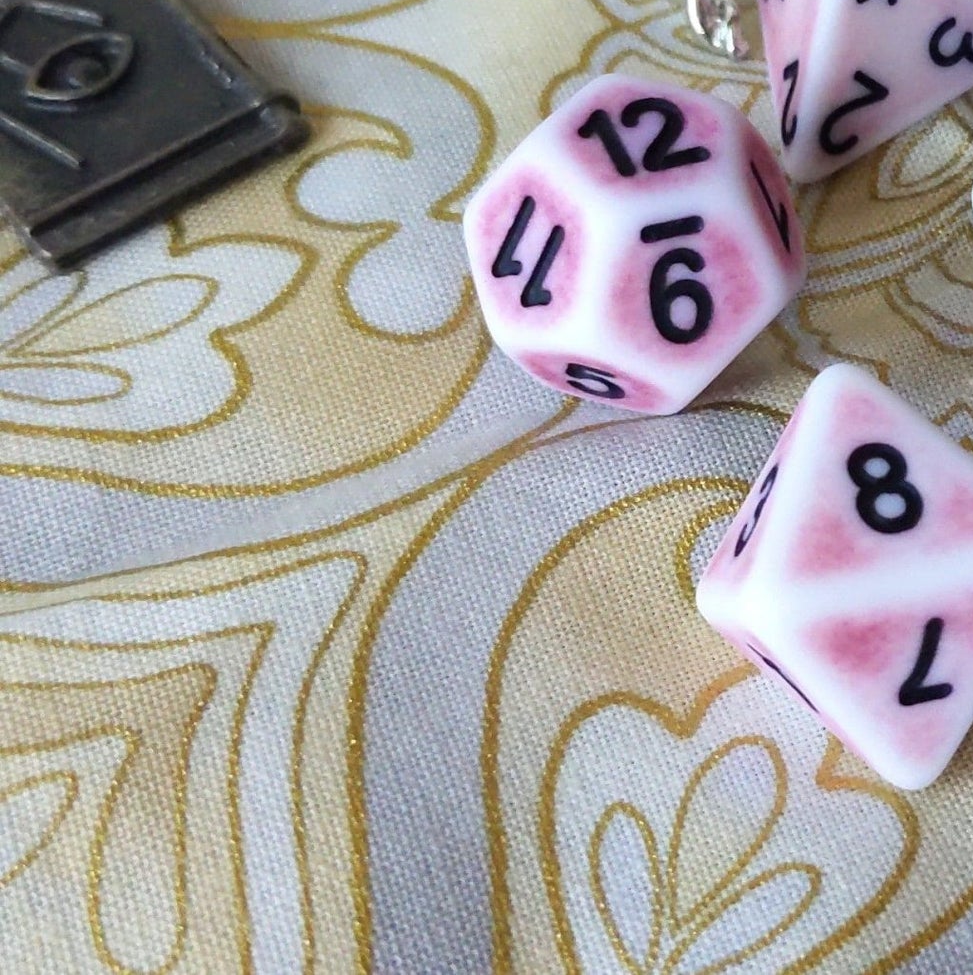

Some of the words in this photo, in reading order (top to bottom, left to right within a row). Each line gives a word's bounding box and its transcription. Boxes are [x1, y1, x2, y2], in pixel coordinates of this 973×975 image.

[575, 96, 712, 179] 12
[818, 70, 889, 155] 2
[490, 195, 566, 308] 11
[564, 362, 626, 400] 5
[845, 442, 925, 536] 8
[897, 616, 954, 707] 7
